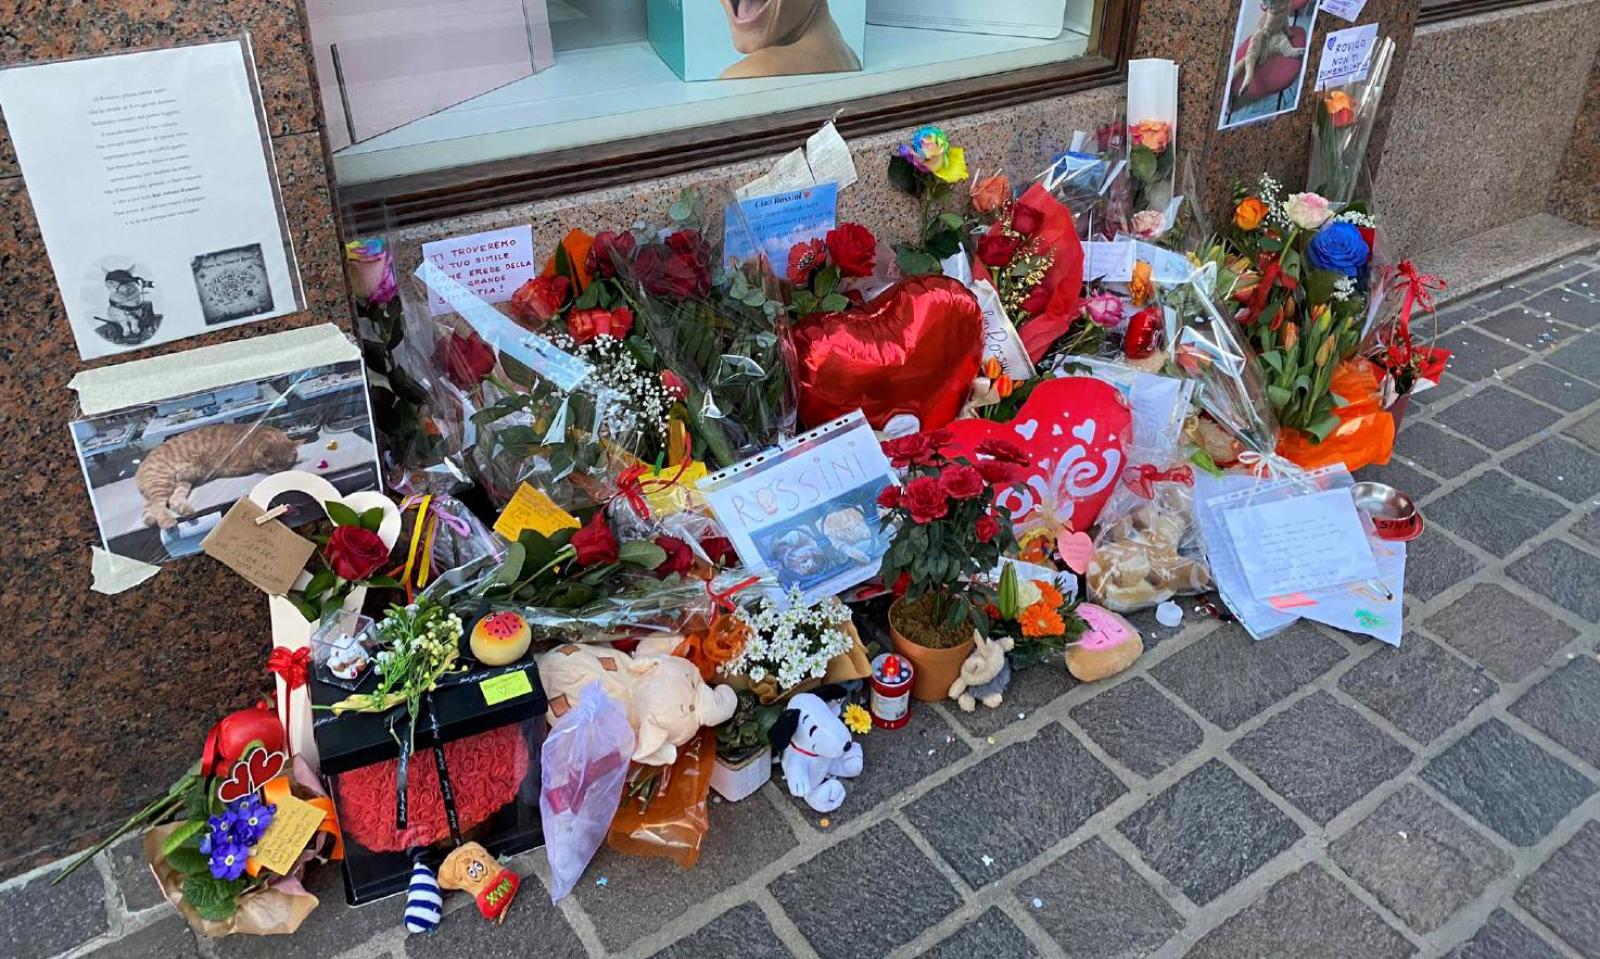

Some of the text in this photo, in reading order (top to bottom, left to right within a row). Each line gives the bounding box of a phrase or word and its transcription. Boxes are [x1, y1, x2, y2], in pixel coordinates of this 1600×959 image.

[432, 239, 517, 262] TI TROVEREMO
[449, 260, 470, 269] TUO
[475, 252, 510, 263] SIMILE
[469, 266, 501, 277] EREDE
[505, 260, 532, 270] DELLA
[467, 275, 507, 287] GRANDE
